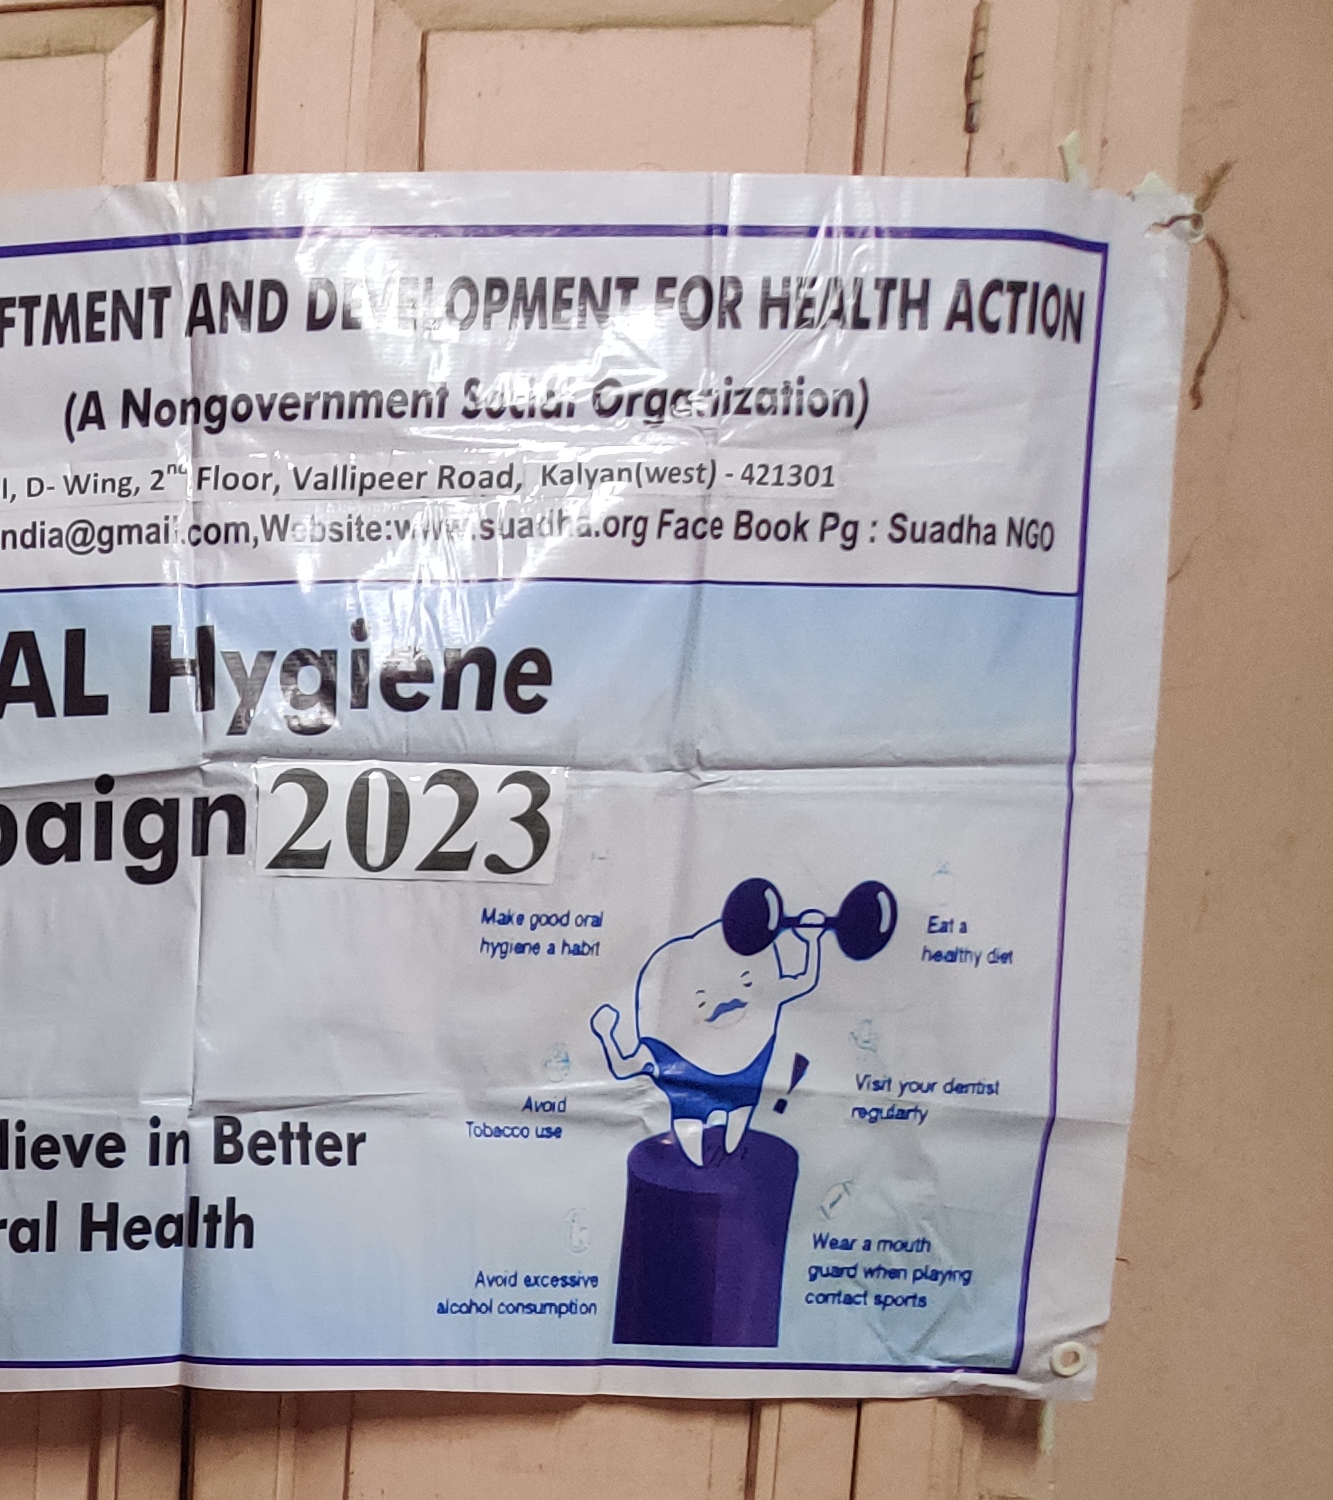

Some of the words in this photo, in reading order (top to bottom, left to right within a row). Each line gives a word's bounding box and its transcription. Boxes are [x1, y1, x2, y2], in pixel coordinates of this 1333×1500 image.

[185, 278, 288, 338] AND
[656, 275, 740, 332] FOR
[758, 275, 929, 333] HEALTH
[945, 277, 1084, 344] ACTION
[64, 390, 107, 443] (A
[121, 381, 450, 435] Nongovernment
[592, 376, 869, 431] Organization)
[26, 475, 56, 500] D-
[63, 469, 139, 500] Wing,
[197, 464, 281, 496] Floor,
[293, 464, 428, 497] Vallipeer
[437, 462, 523, 493] Road,
[541, 460, 719, 491] Kalyan(west)
[739, 461, 836, 489] 421301
[656, 513, 725, 543] Face
[733, 513, 809, 544] Book
[819, 515, 861, 551] Pg
[887, 513, 997, 548] Suadha
[1007, 516, 1055, 552] NGO
[149, 617, 553, 736] Hygiene
[265, 766, 553, 876] 2023
[480, 906, 525, 928] Make
[529, 908, 568, 932] good
[572, 909, 604, 928] oral
[928, 915, 953, 935] Eat
[479, 939, 542, 960] hygiene
[561, 938, 601, 957] habit
[921, 944, 983, 967] healthy
[986, 946, 1015, 964] diet
[855, 1073, 893, 1094] Visit
[898, 1078, 938, 1099] your
[942, 1077, 1000, 1097] dentist
[522, 1095, 567, 1114] Avoid
[148, 1115, 190, 1167] in
[212, 1115, 367, 1167] Better
[466, 1120, 530, 1140] Tobacco
[535, 1125, 562, 1139] use
[79, 1196, 255, 1253] Health
[813, 1233, 856, 1253] Wear
[877, 1236, 931, 1255] mouth
[475, 1270, 518, 1290] Avoid
[523, 1271, 600, 1291] excessive
[808, 1263, 858, 1286] guard
[863, 1264, 909, 1283] when
[912, 1263, 972, 1287] playing
[436, 1298, 493, 1317] alcohol
[497, 1298, 598, 1320] consumption
[805, 1289, 868, 1308] contact
[873, 1290, 927, 1312] sports
